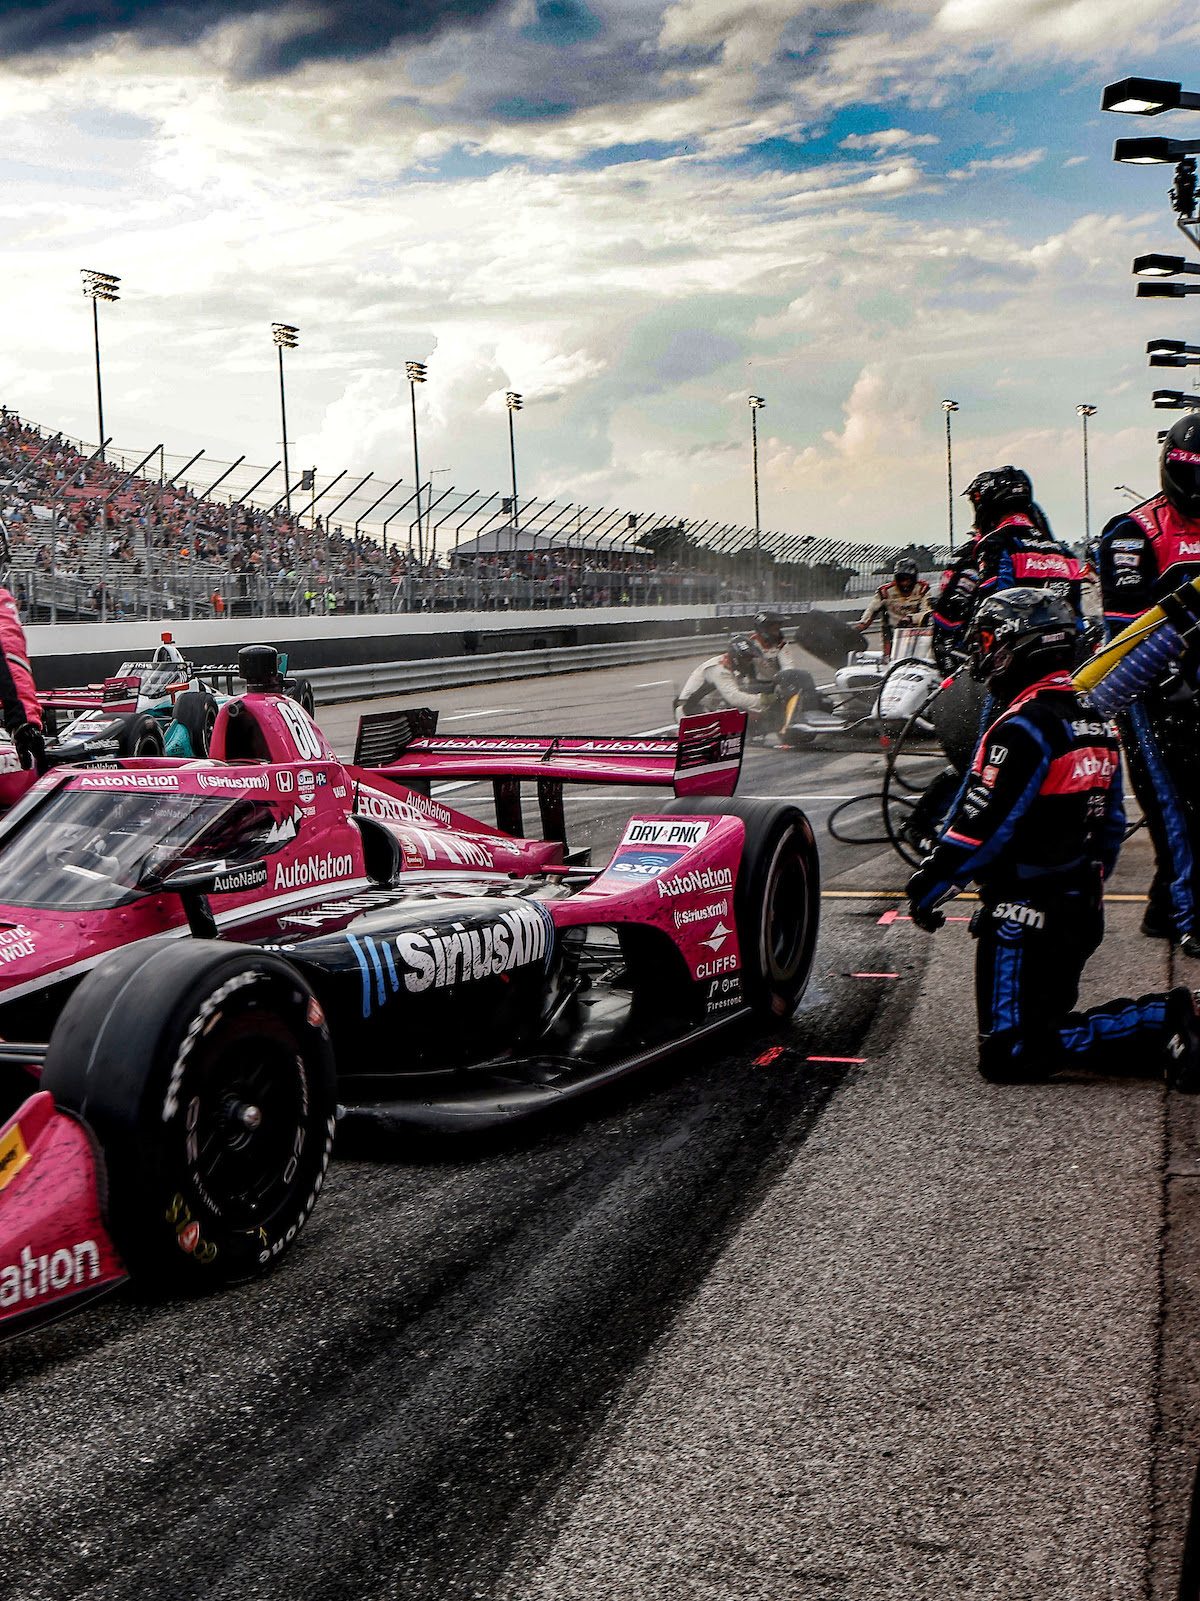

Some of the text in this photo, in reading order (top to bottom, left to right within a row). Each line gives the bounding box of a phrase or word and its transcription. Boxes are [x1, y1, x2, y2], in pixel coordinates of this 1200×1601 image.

[277, 701, 323, 760] 60
[409, 739, 541, 751] AutoNation
[80, 774, 179, 788] AutoNation
[353, 794, 428, 823] HONDA
[405, 790, 452, 824] AutoNation
[629, 825, 702, 843] DRV PNK
[212, 868, 268, 892] AutoNation
[273, 851, 353, 891] AutoNation
[656, 867, 732, 899] AutoNation
[991, 902, 1046, 930] sxm
[695, 954, 738, 979] CLIFFS
